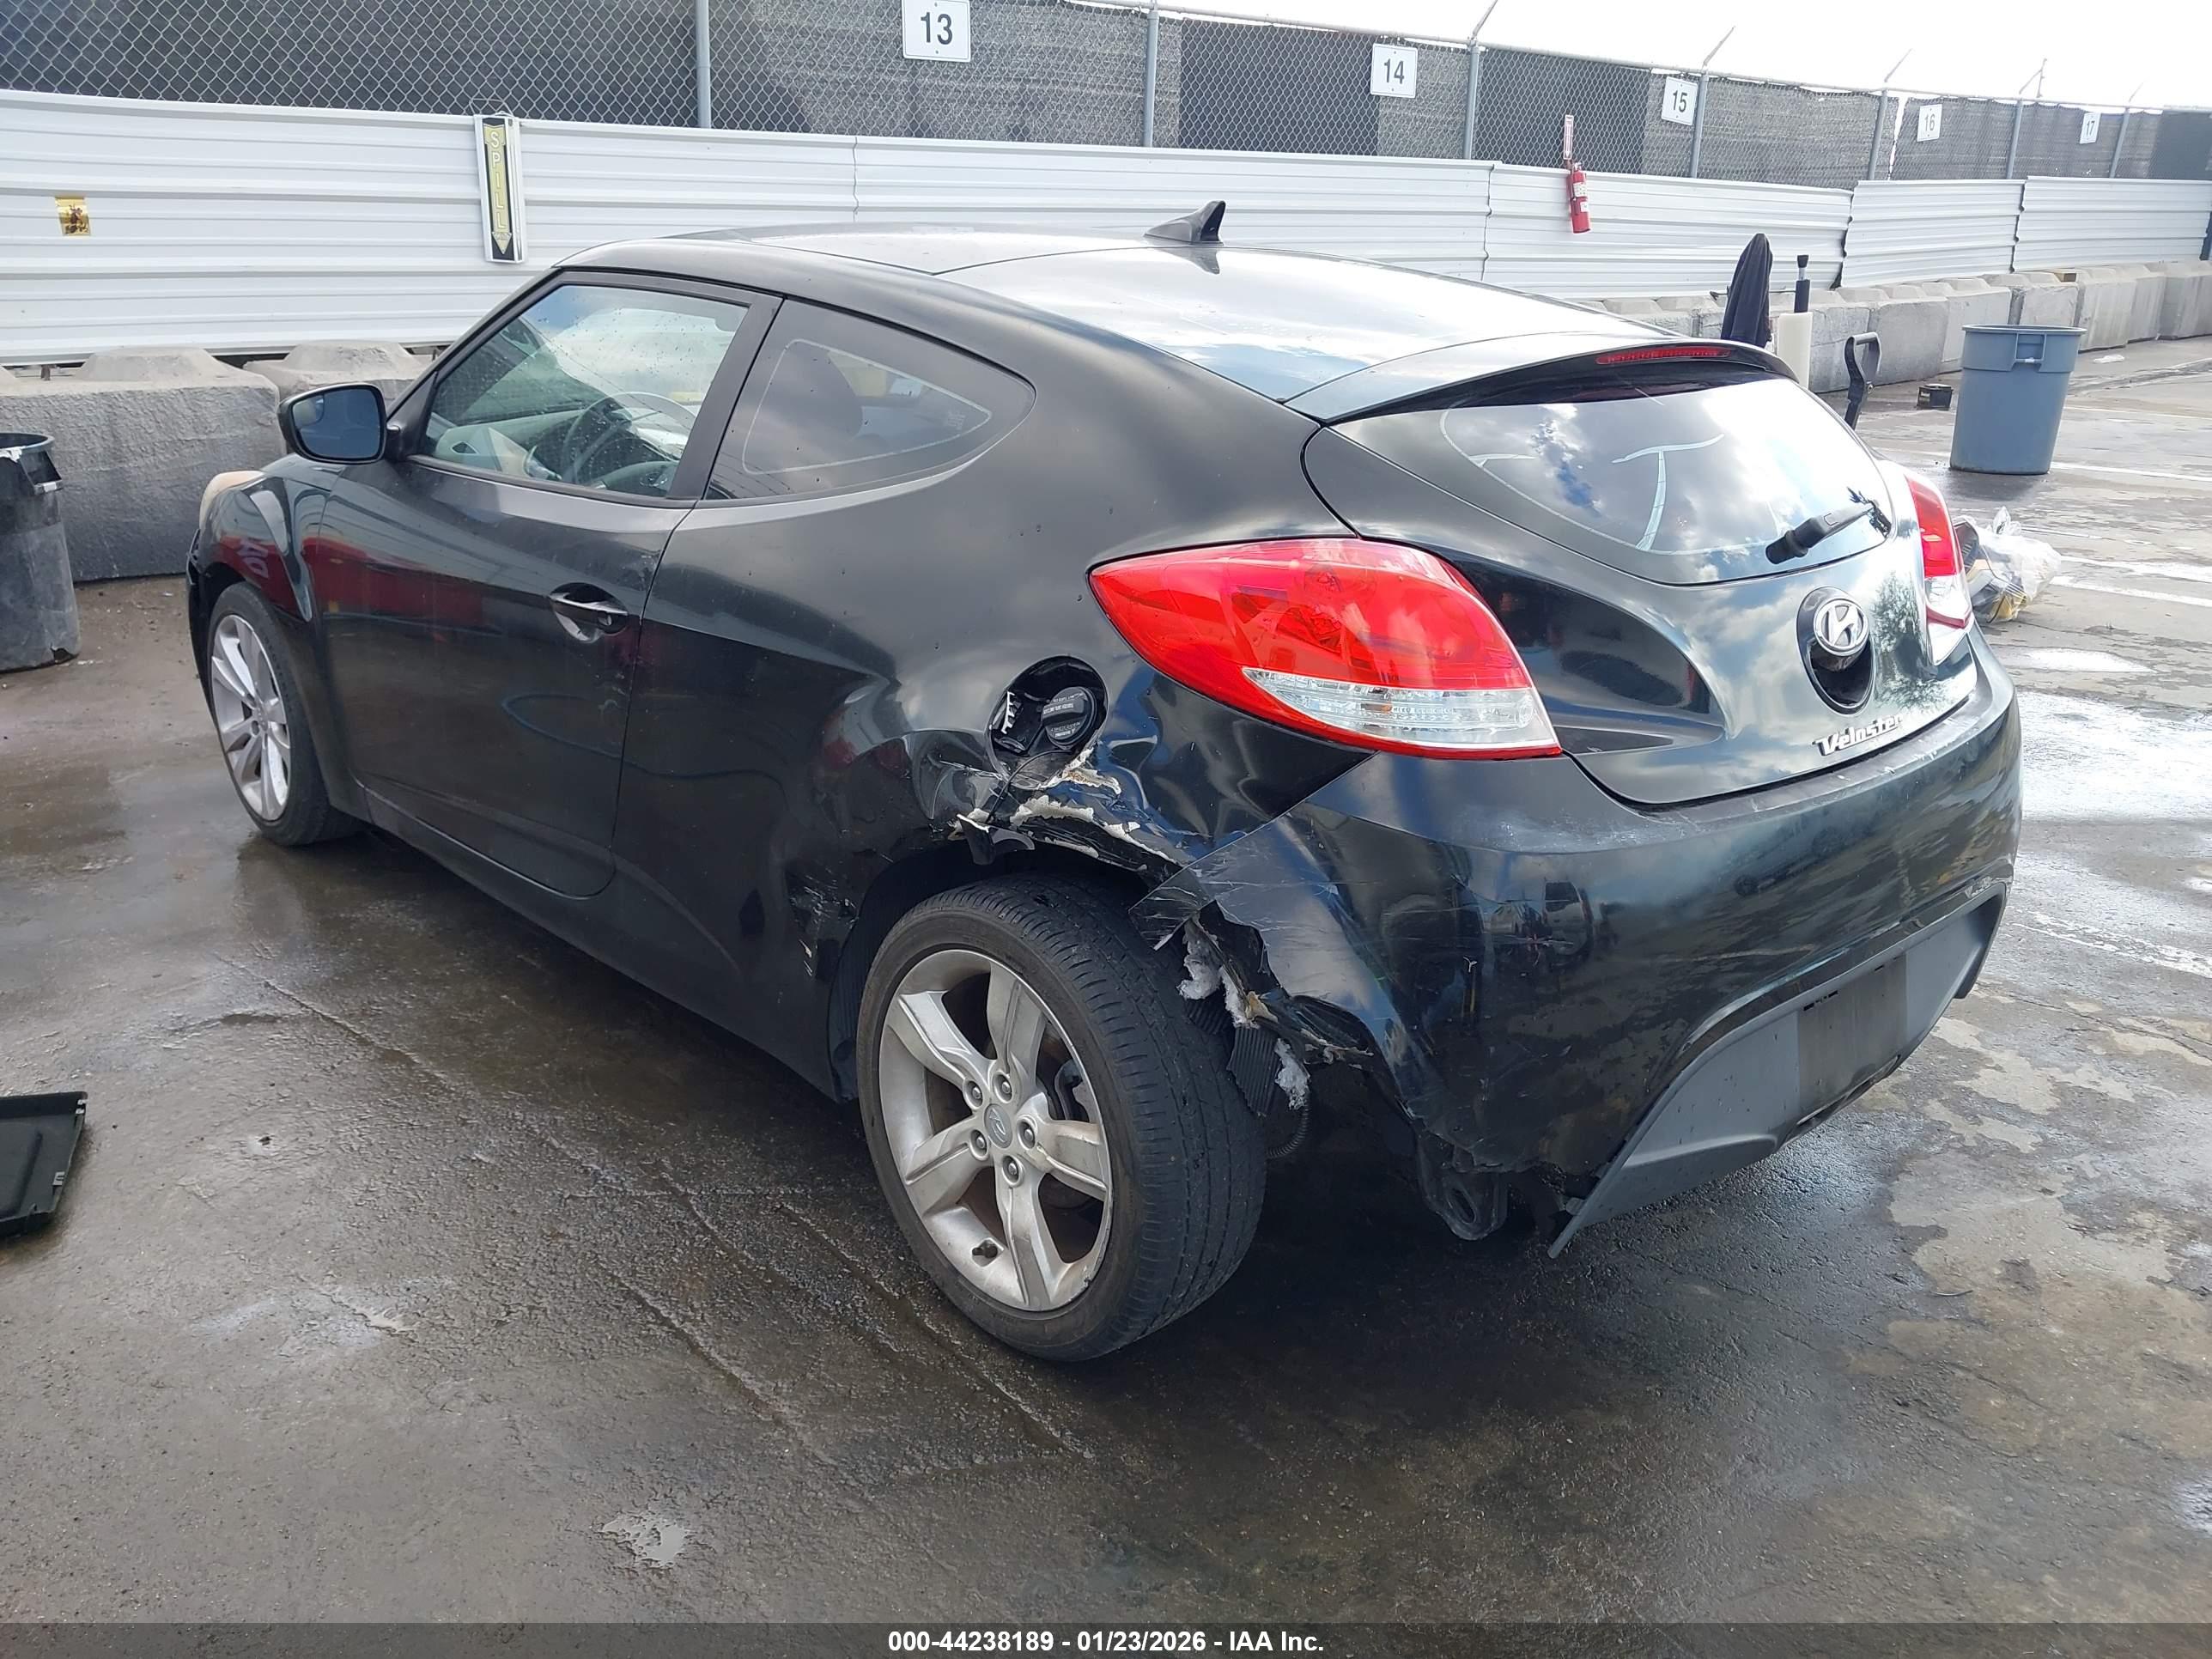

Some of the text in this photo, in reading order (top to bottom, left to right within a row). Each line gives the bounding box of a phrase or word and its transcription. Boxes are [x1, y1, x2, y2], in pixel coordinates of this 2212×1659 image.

[920, 11, 953, 46] 13
[1383, 58, 1405, 85] 14
[1672, 89, 1688, 113] 15
[1923, 113, 1936, 131] 16
[2086, 120, 2096, 137] 17
[490, 131, 506, 229] SPILL
